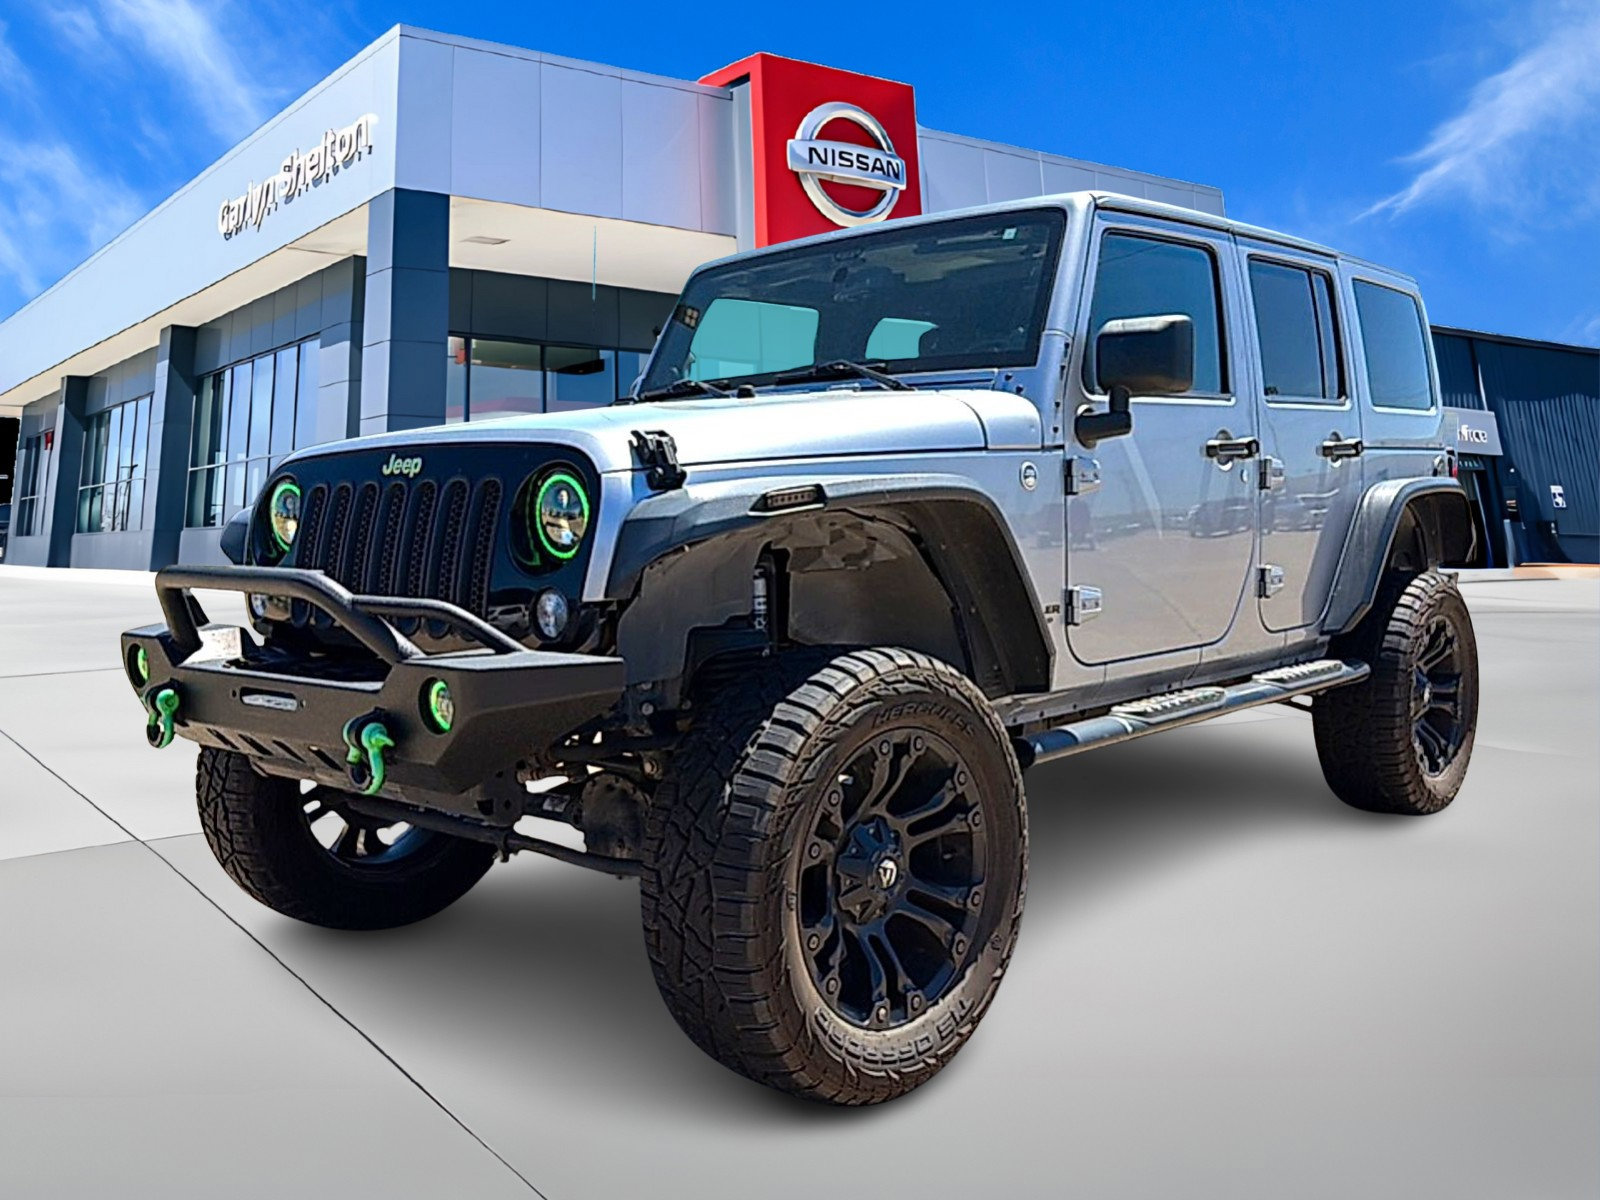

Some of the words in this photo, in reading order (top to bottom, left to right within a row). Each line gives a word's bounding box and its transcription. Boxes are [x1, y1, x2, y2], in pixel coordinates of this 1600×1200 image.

[279, 117, 374, 203] Shelton
[807, 146, 900, 179] NISSAN
[382, 453, 423, 478] Jeep
